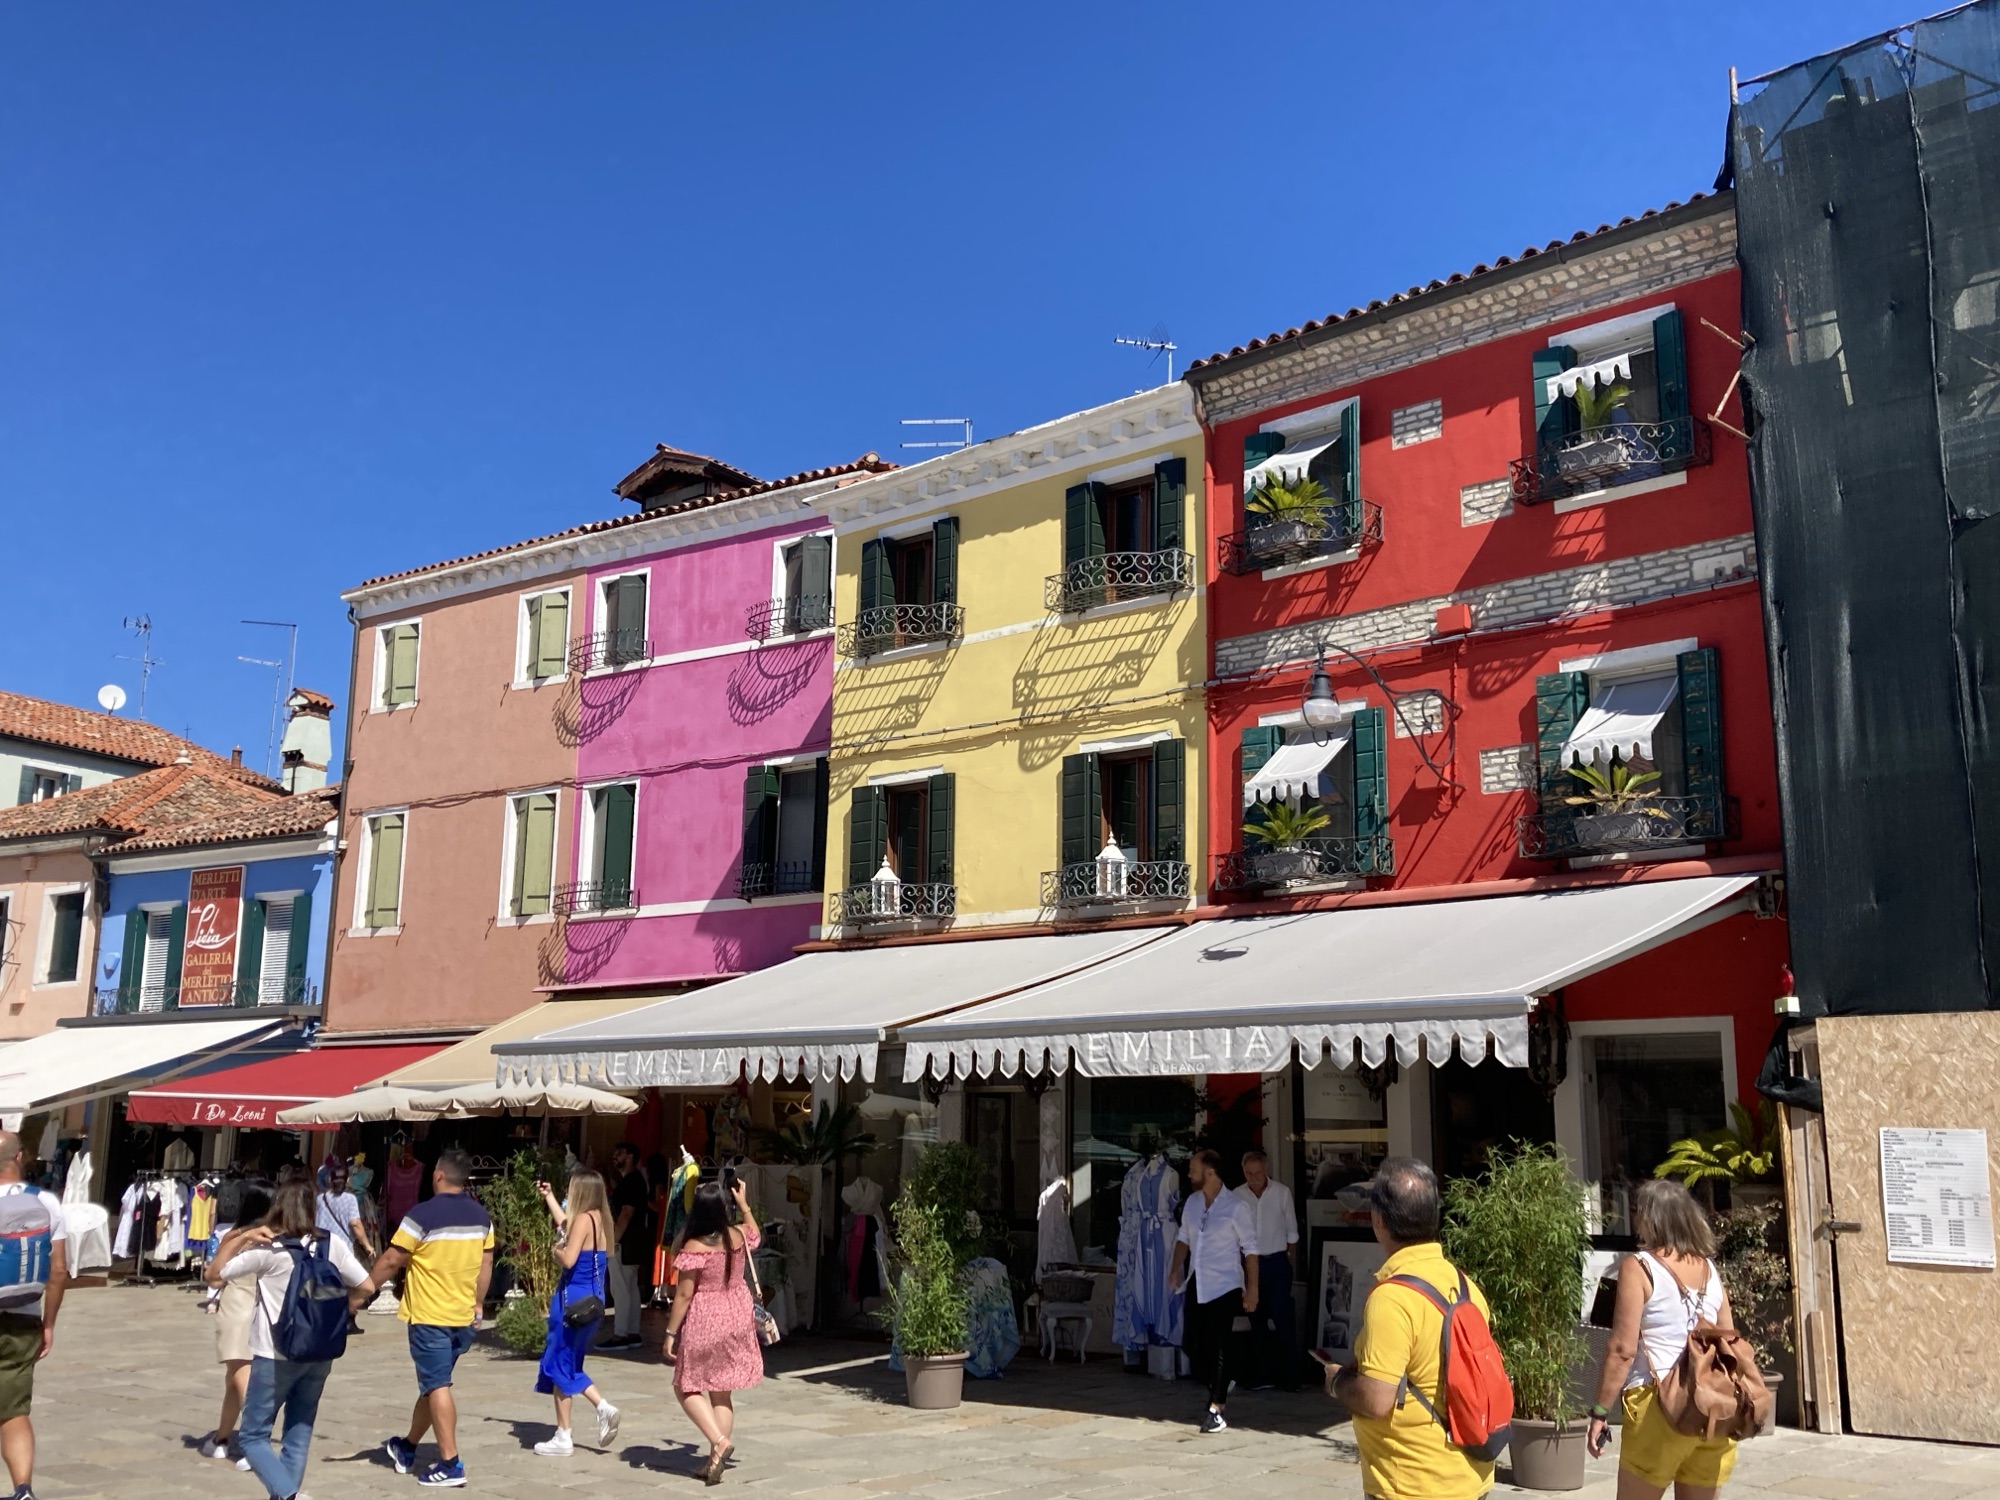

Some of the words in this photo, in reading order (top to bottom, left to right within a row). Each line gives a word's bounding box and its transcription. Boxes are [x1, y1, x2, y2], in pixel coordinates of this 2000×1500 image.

[194, 871, 240, 886] MERLETTI
[192, 887, 227, 901] D'ARTE
[187, 903, 236, 949] Lidia
[185, 952, 232, 966] GALLERIA
[203, 966, 212, 976] del
[182, 974, 233, 989] MERLETTO
[1088, 1026, 1273, 1063] EMILIA
[613, 1049, 729, 1075] EMILIA
[1151, 1061, 1205, 1073] BURANO
[192, 1102, 203, 1120] I
[204, 1103, 226, 1122] Do
[228, 1105, 267, 1122] Leoni
